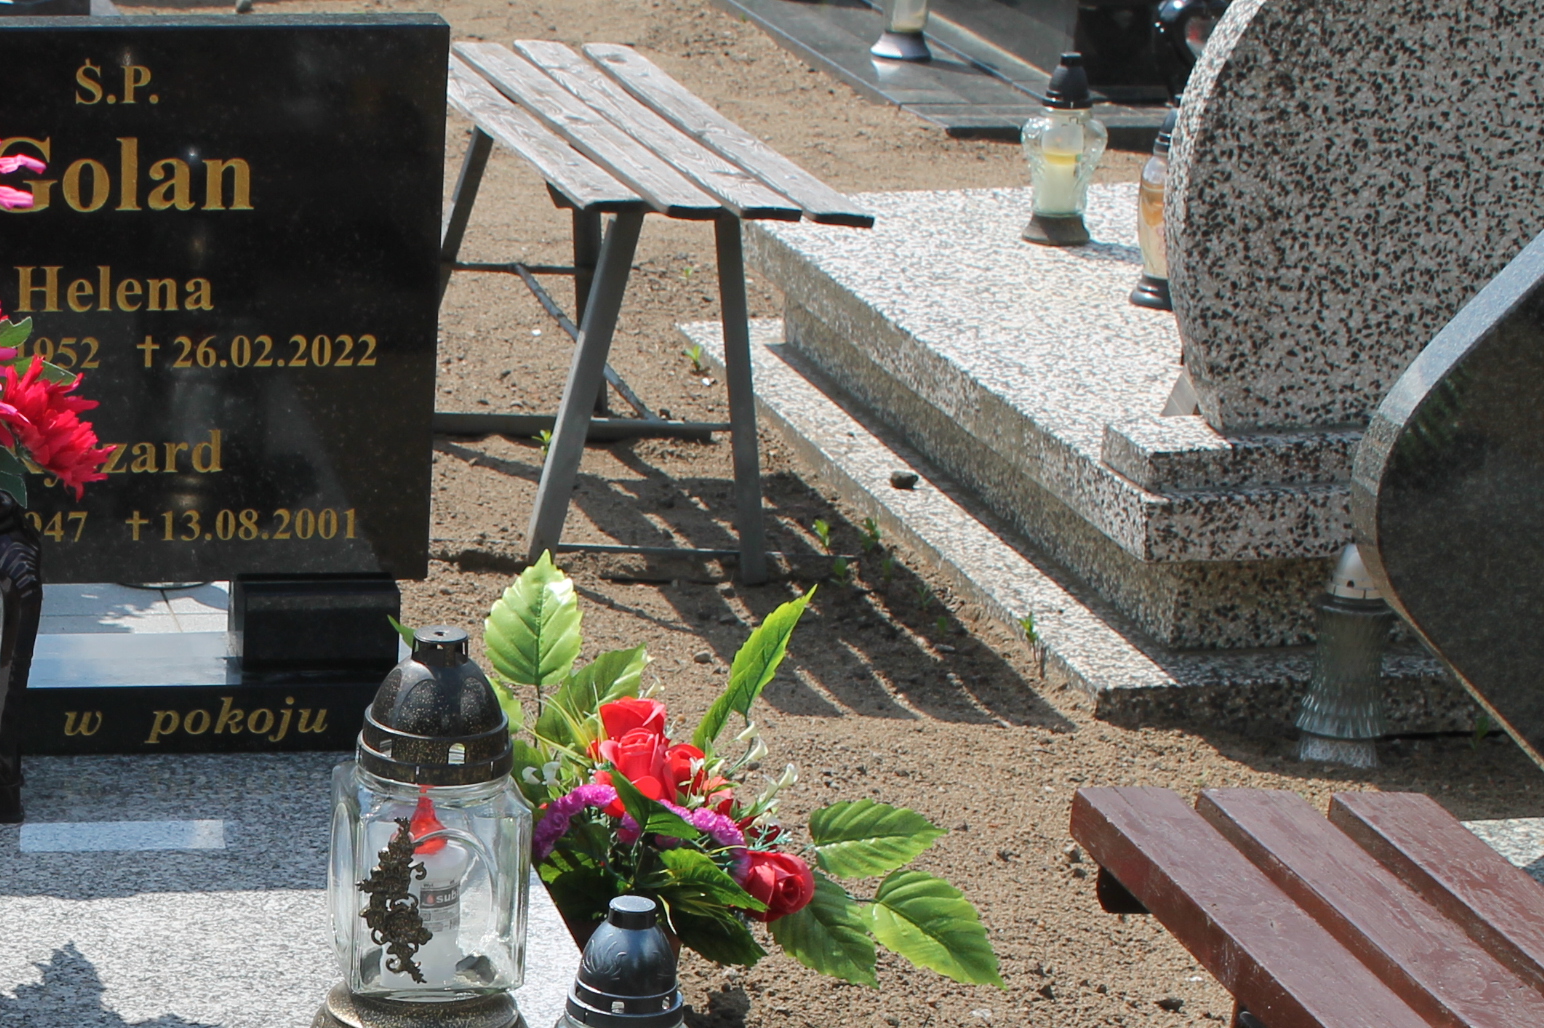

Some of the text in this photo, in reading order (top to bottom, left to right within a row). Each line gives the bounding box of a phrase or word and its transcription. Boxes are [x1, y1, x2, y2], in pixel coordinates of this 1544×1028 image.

[12, 264, 214, 313] Helena
[172, 334, 378, 369] 26.02.2022
[160, 507, 359, 542] 13.08.2001
[63, 696, 329, 744] w pokoju
